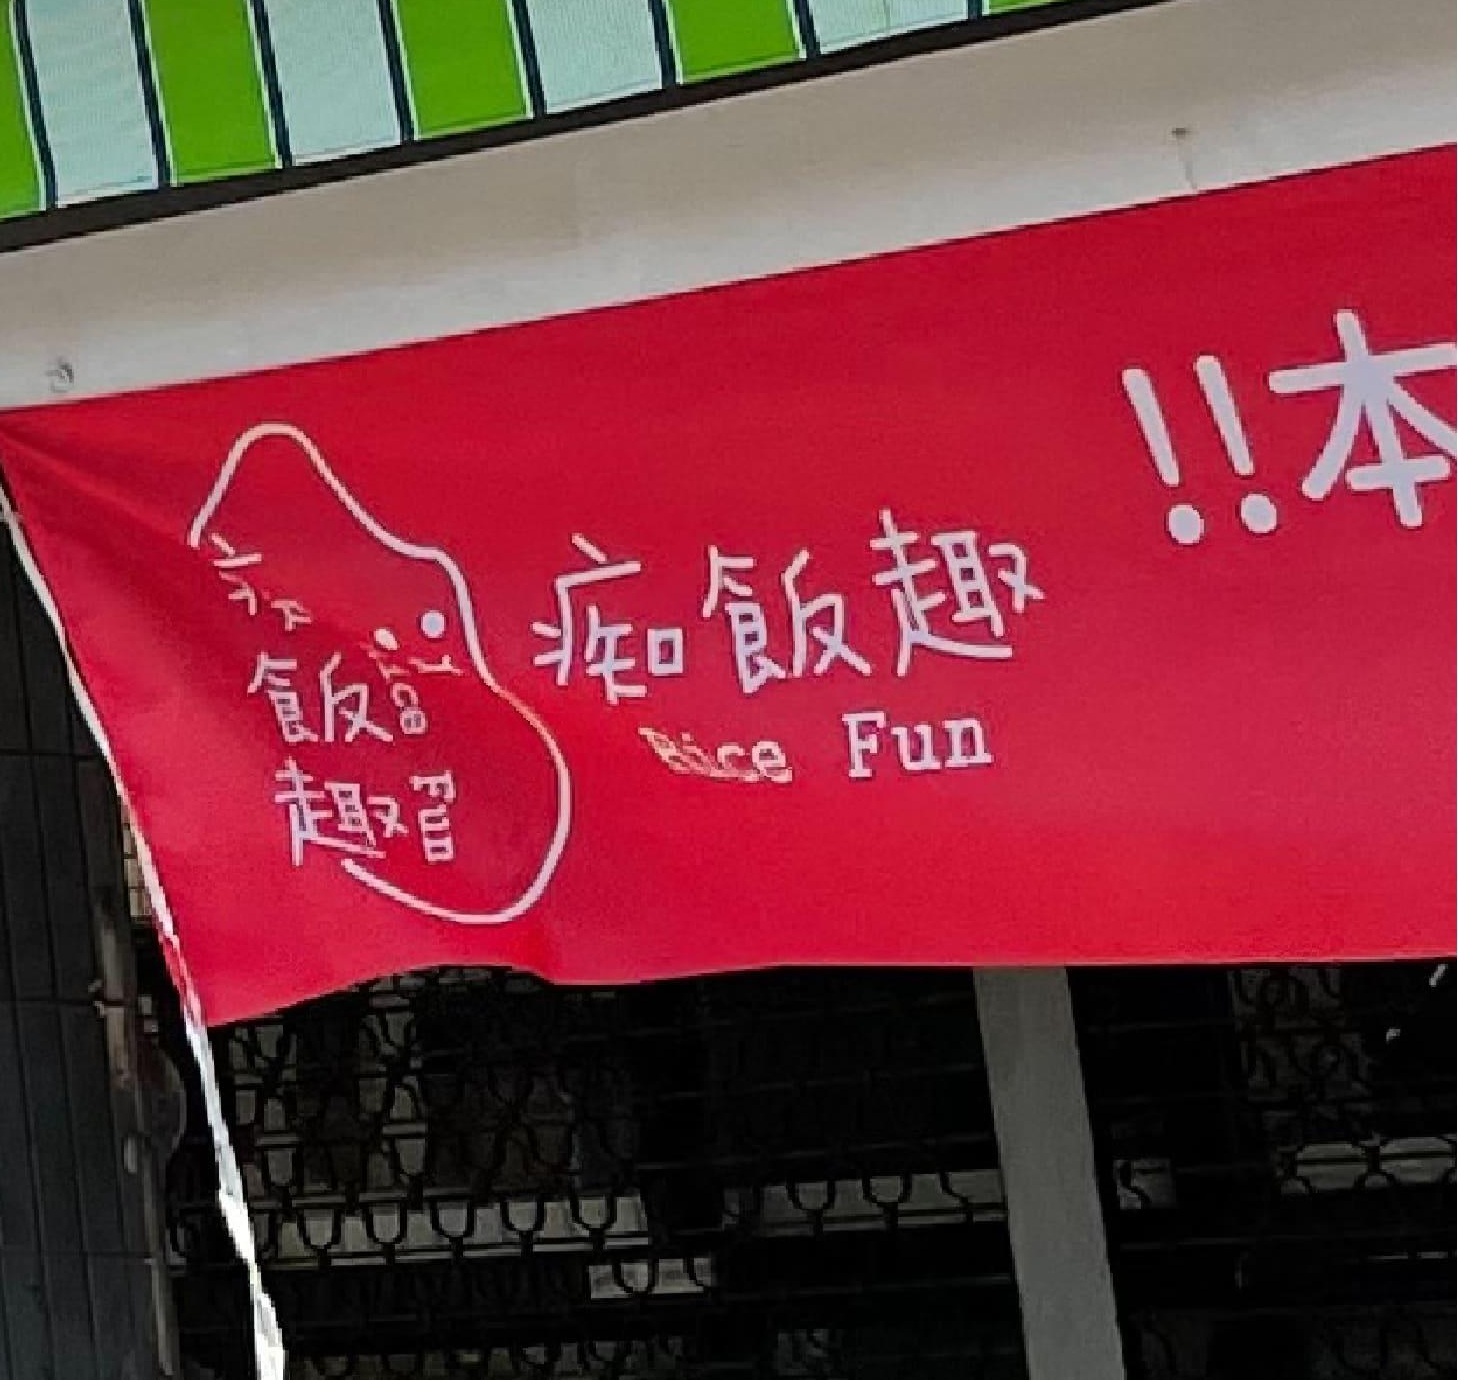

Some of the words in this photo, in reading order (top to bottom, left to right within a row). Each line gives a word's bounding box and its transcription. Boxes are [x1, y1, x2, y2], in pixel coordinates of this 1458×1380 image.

[530, 506, 1047, 706] 痴飯趣
[840, 710, 994, 779] Fun
[409, 768, 457, 863] Fun
